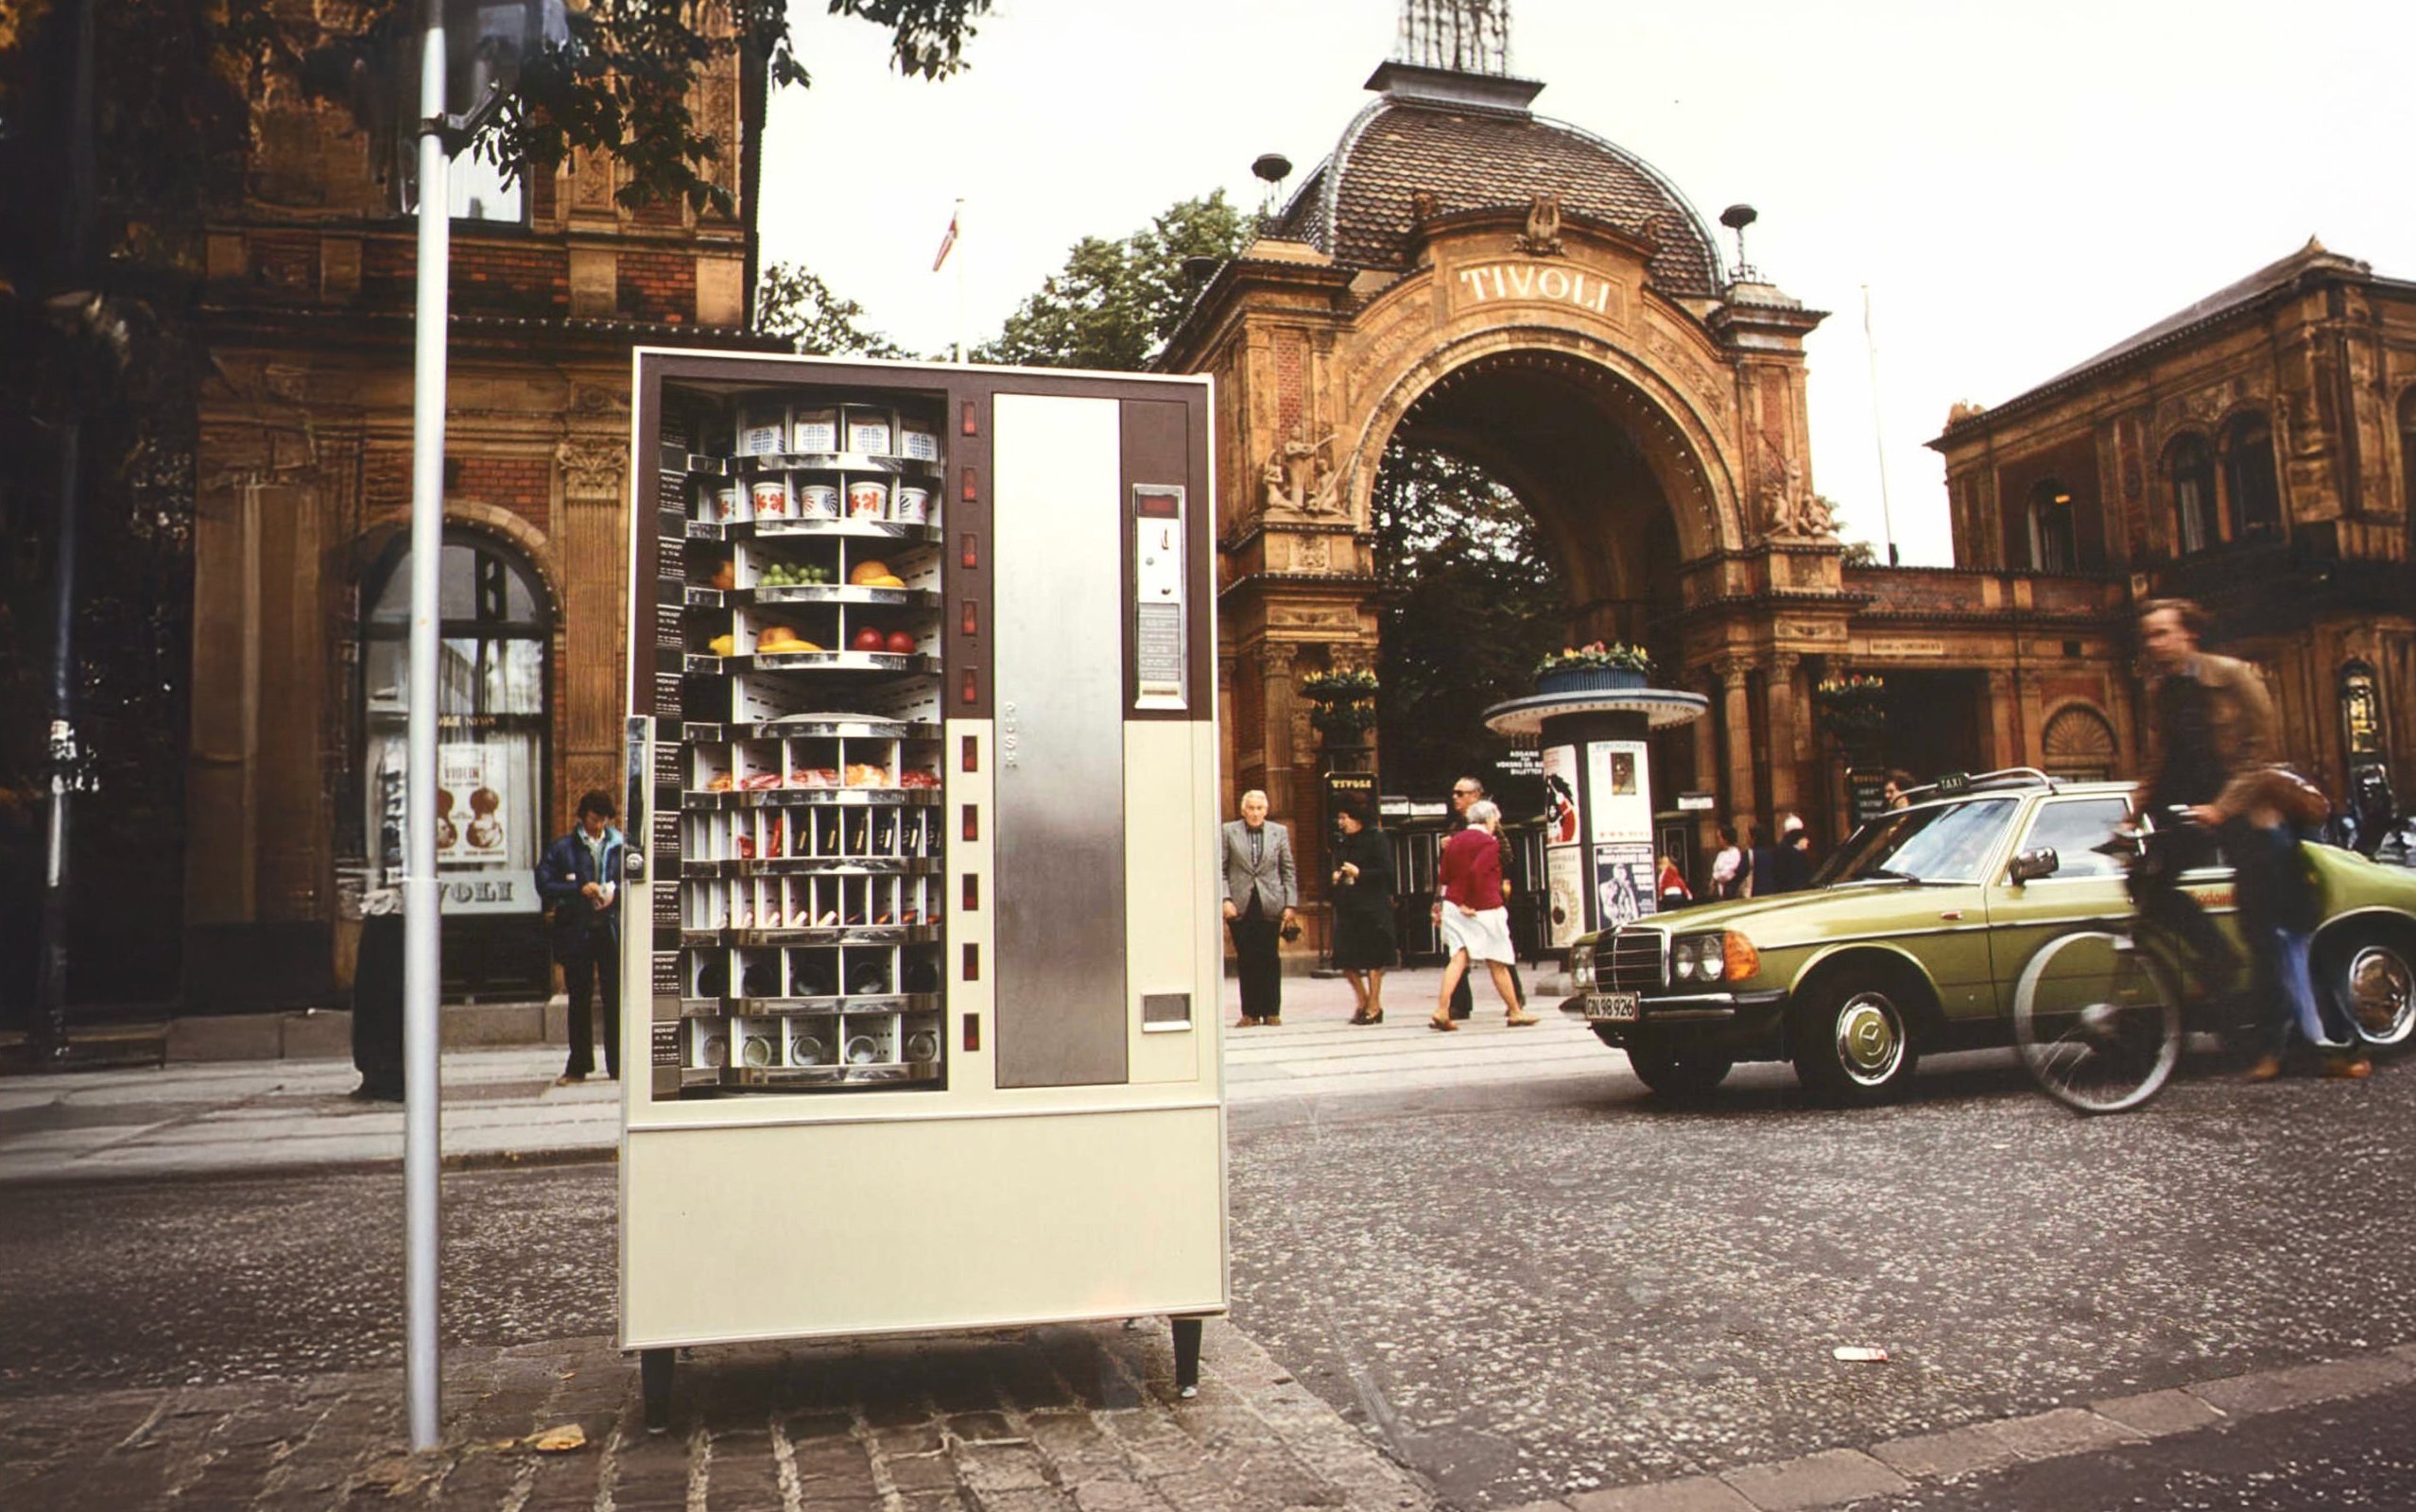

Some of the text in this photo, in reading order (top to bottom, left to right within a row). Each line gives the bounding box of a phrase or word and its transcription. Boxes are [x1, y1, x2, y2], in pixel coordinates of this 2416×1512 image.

[1459, 265, 1610, 314] TIVOLI
[1941, 777, 1963, 789] TAXI
[1614, 998, 1634, 1017] 926
